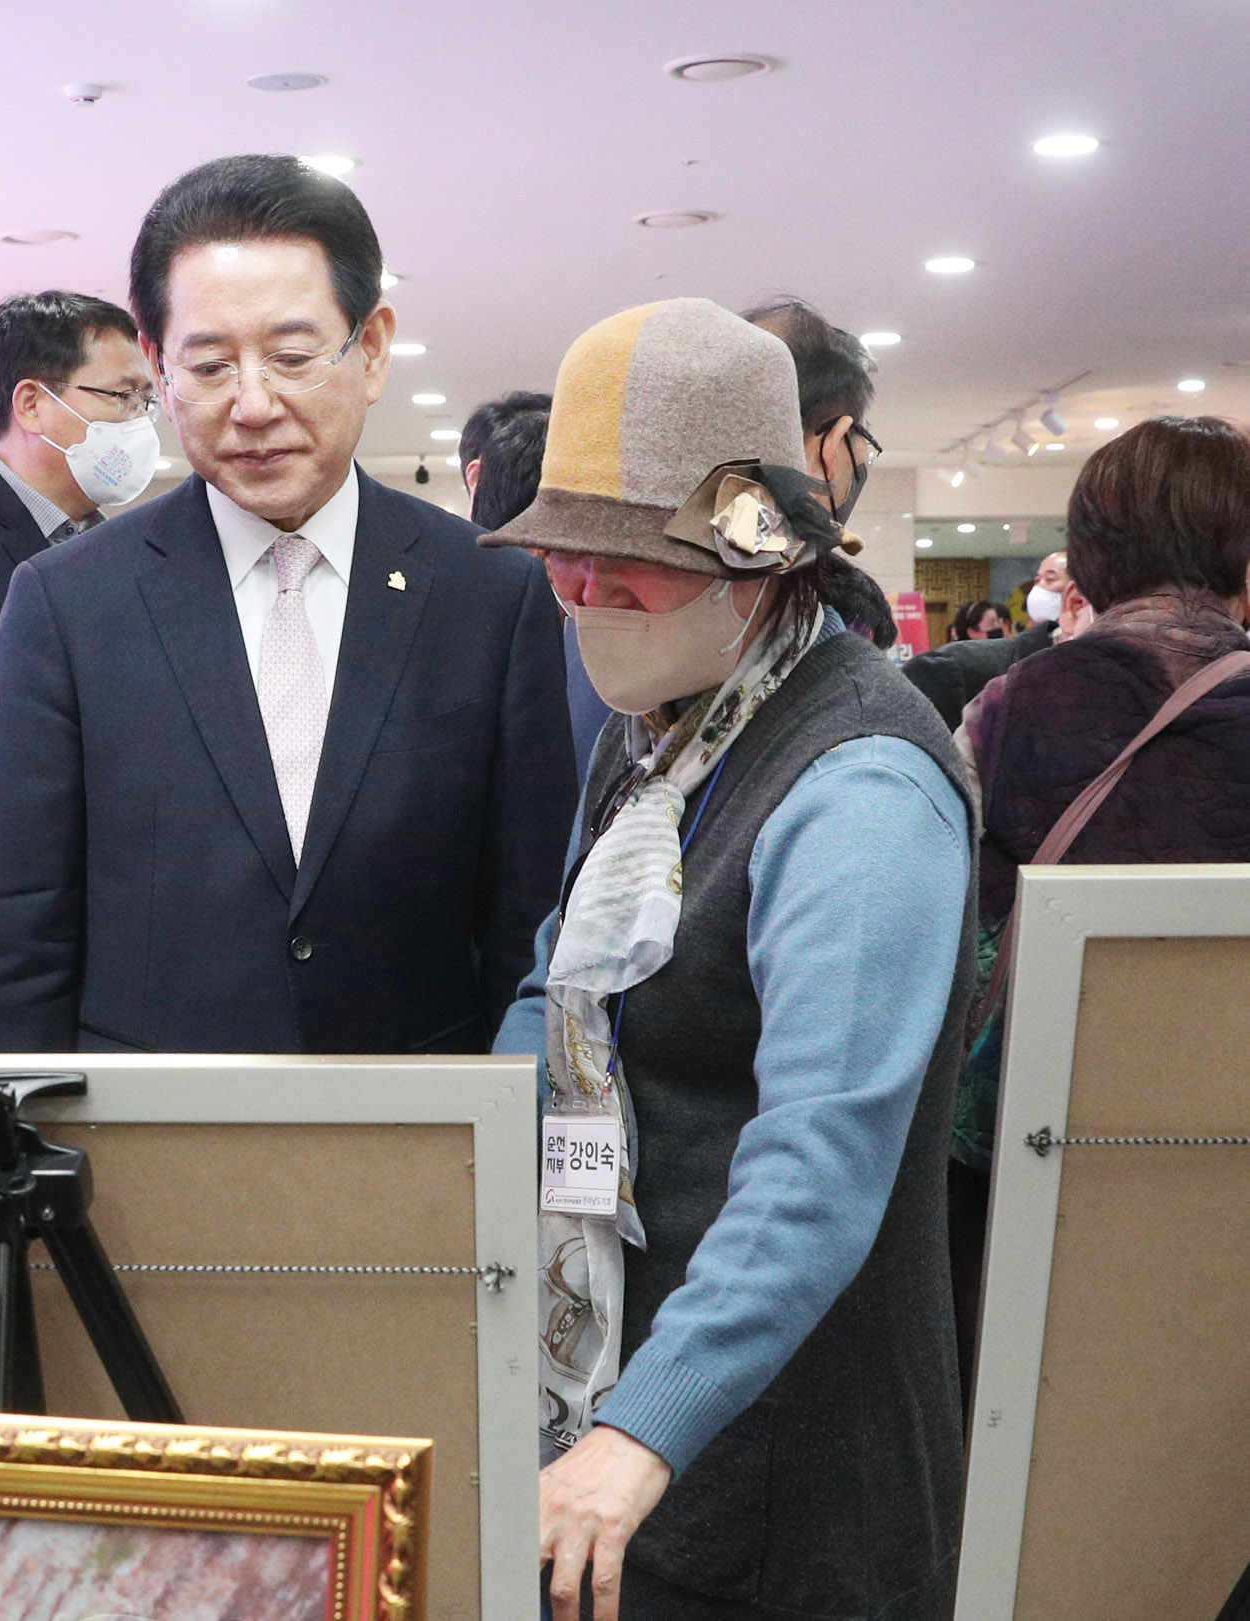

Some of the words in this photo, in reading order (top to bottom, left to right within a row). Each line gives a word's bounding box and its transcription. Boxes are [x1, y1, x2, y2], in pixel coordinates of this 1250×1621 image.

[547, 1136, 566, 1152] 순천
[569, 1141, 615, 1171] 강인숙
[546, 1157, 565, 1174] 지부
